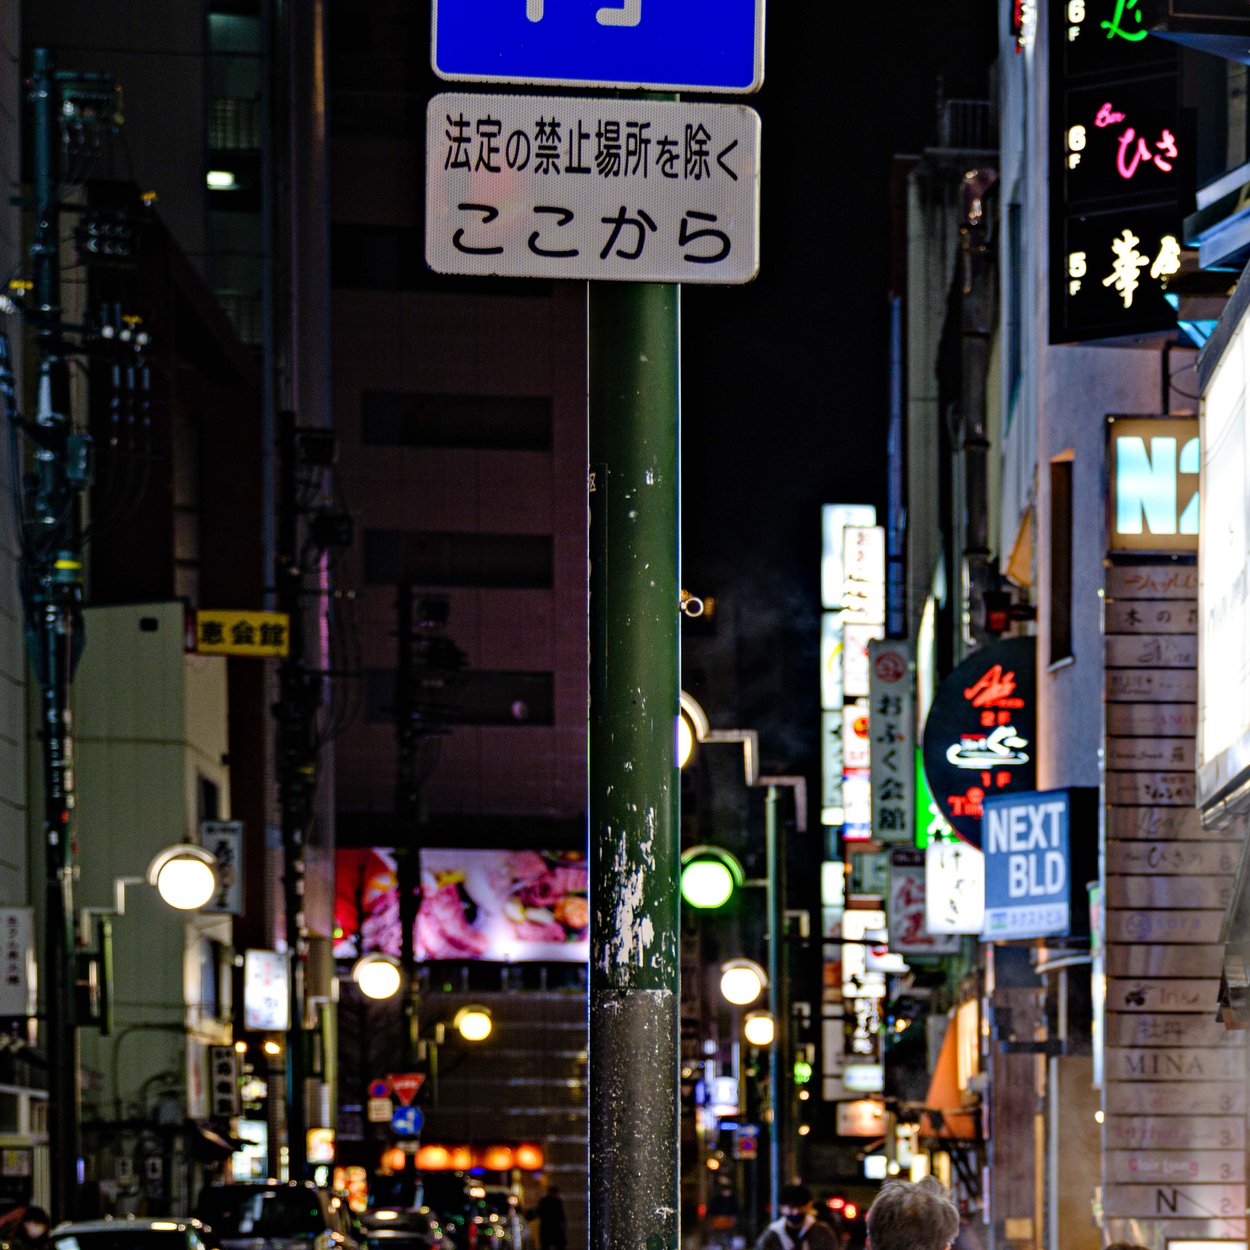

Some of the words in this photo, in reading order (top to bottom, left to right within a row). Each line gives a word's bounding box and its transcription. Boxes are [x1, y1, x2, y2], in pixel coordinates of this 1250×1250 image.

[444, 113, 739, 181] 法定の禁止場所を除く
[452, 203, 731, 264] ここから
[988, 801, 1066, 854] NEXT
[1008, 851, 1066, 898] BLD
[1124, 1054, 1204, 1075] MINA
